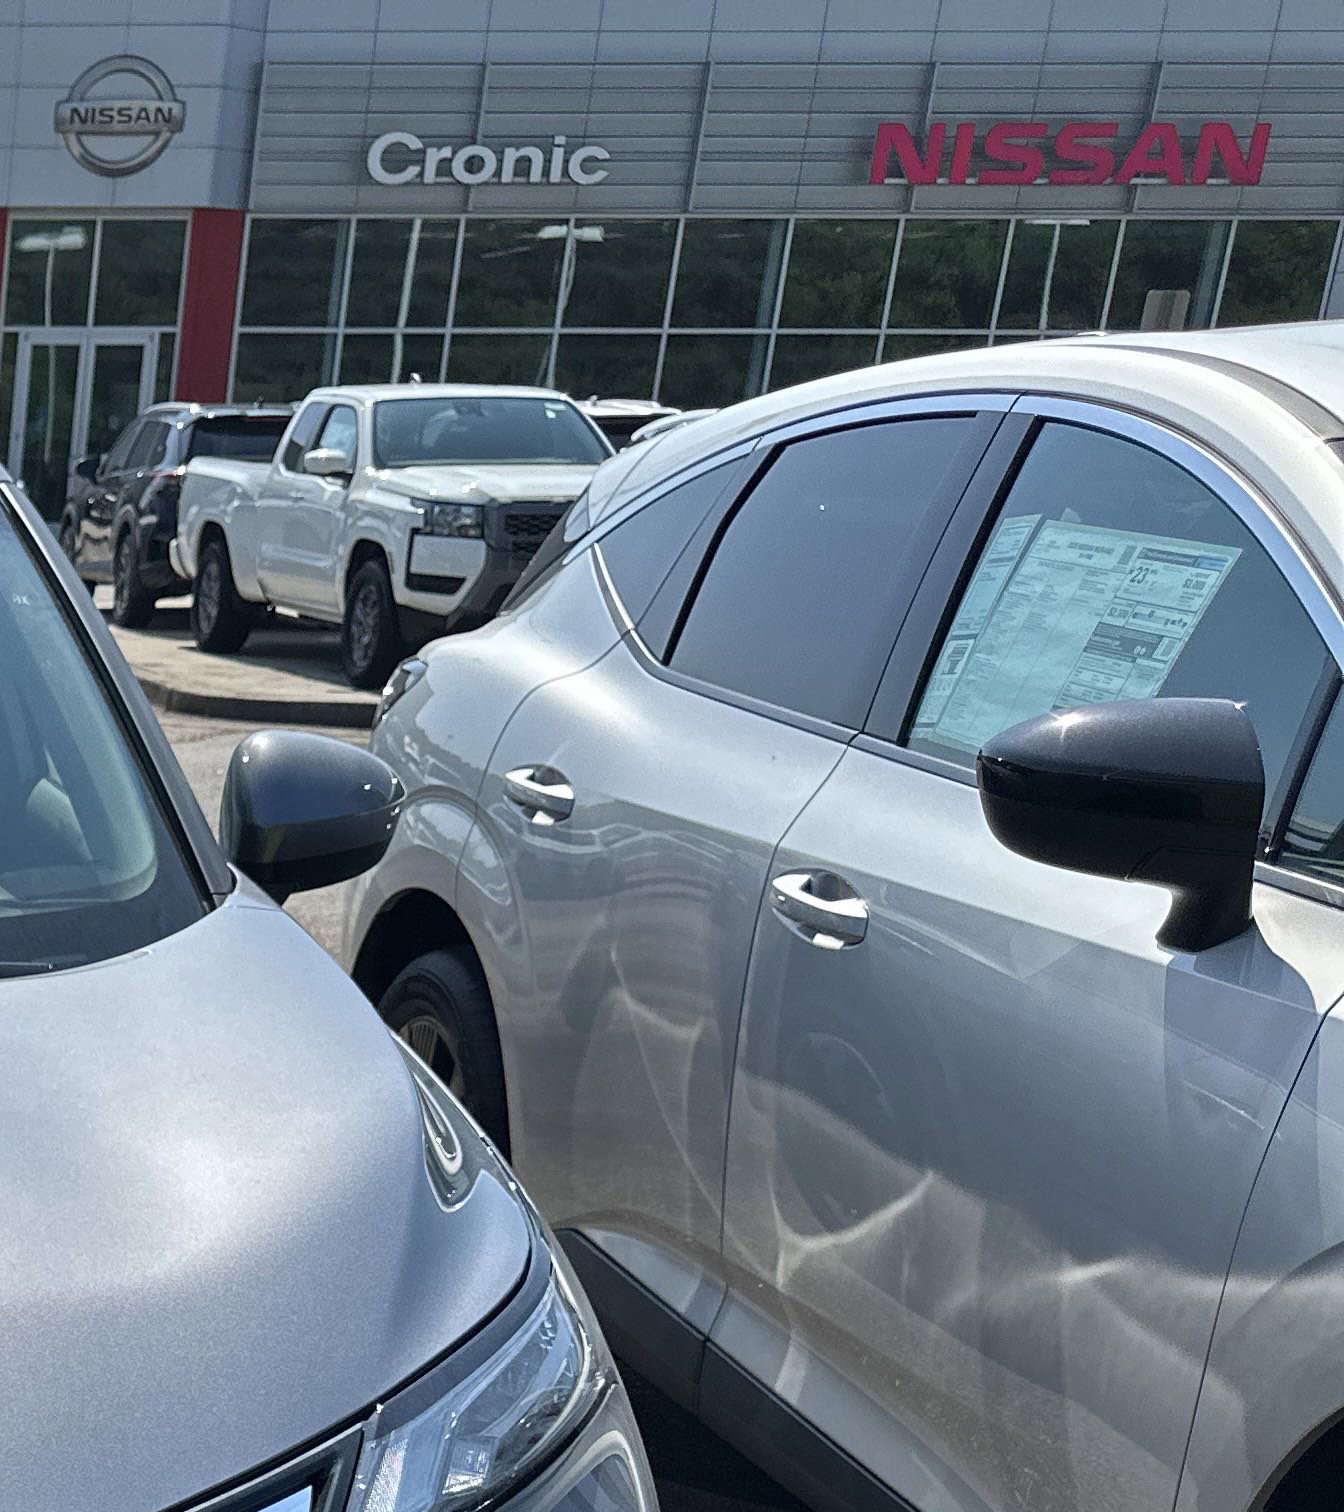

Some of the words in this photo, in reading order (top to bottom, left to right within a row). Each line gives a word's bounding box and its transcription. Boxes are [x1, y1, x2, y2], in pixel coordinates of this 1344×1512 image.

[69, 106, 173, 125] NISSAN
[367, 131, 611, 185] Cronic
[869, 122, 1272, 186] NISSAN
